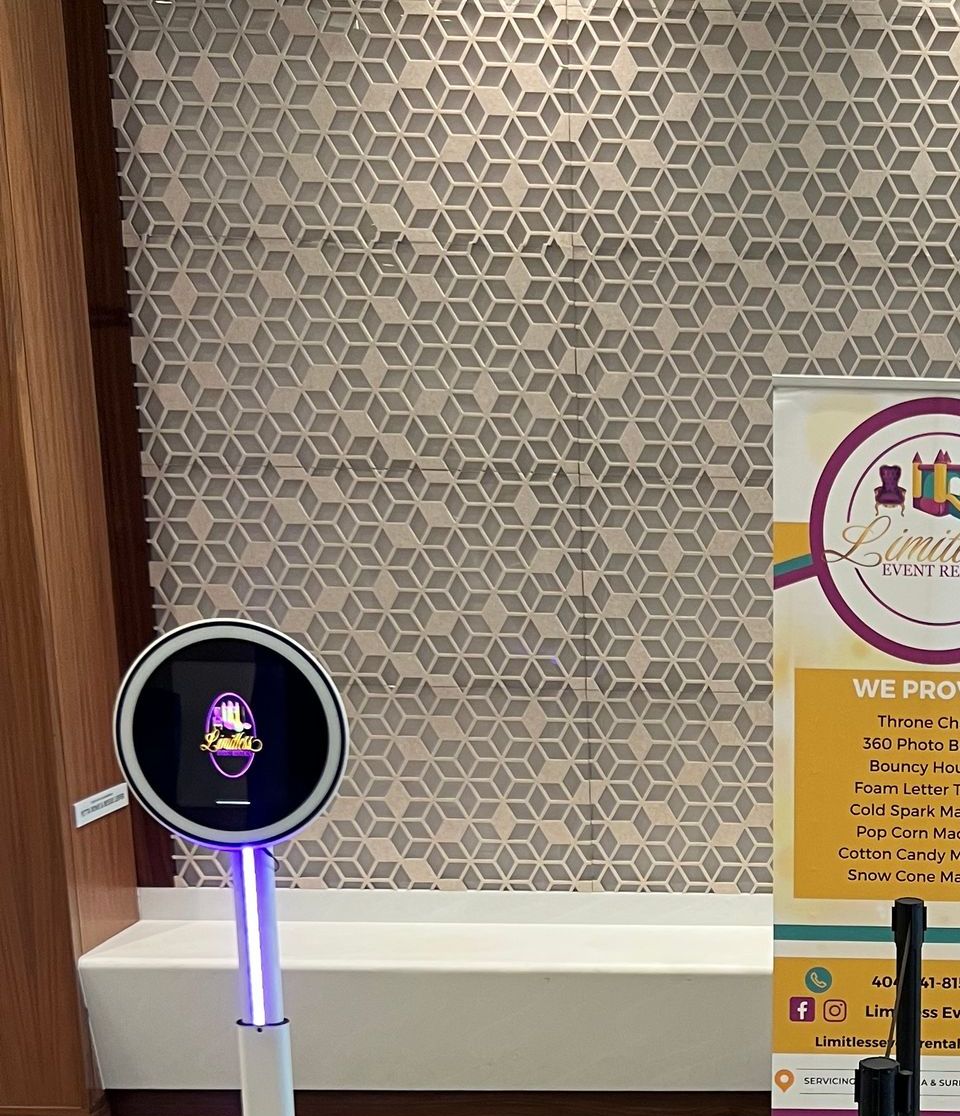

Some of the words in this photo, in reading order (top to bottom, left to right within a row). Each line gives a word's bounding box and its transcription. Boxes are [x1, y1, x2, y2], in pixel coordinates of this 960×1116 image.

[882, 563, 936, 578] EVENT
[852, 678, 896, 699] WE
[877, 715, 934, 730] Throne
[862, 737, 893, 751] 360
[896, 738, 944, 752] Photo
[869, 760, 929, 776] Bouncy
[854, 782, 899, 796] Foam
[903, 783, 949, 797] Letter
[849, 804, 886, 818] Cold
[890, 804, 935, 820] Spark
[856, 827, 887, 842] Pop
[891, 827, 929, 840] Corn
[838, 847, 892, 862] Cotton
[895, 849, 946, 864] Candy
[847, 869, 892, 884] Snow
[895, 870, 936, 884] Cone
[865, 1004, 939, 1019] Limss
[930, 1079, 937, 1087] &
